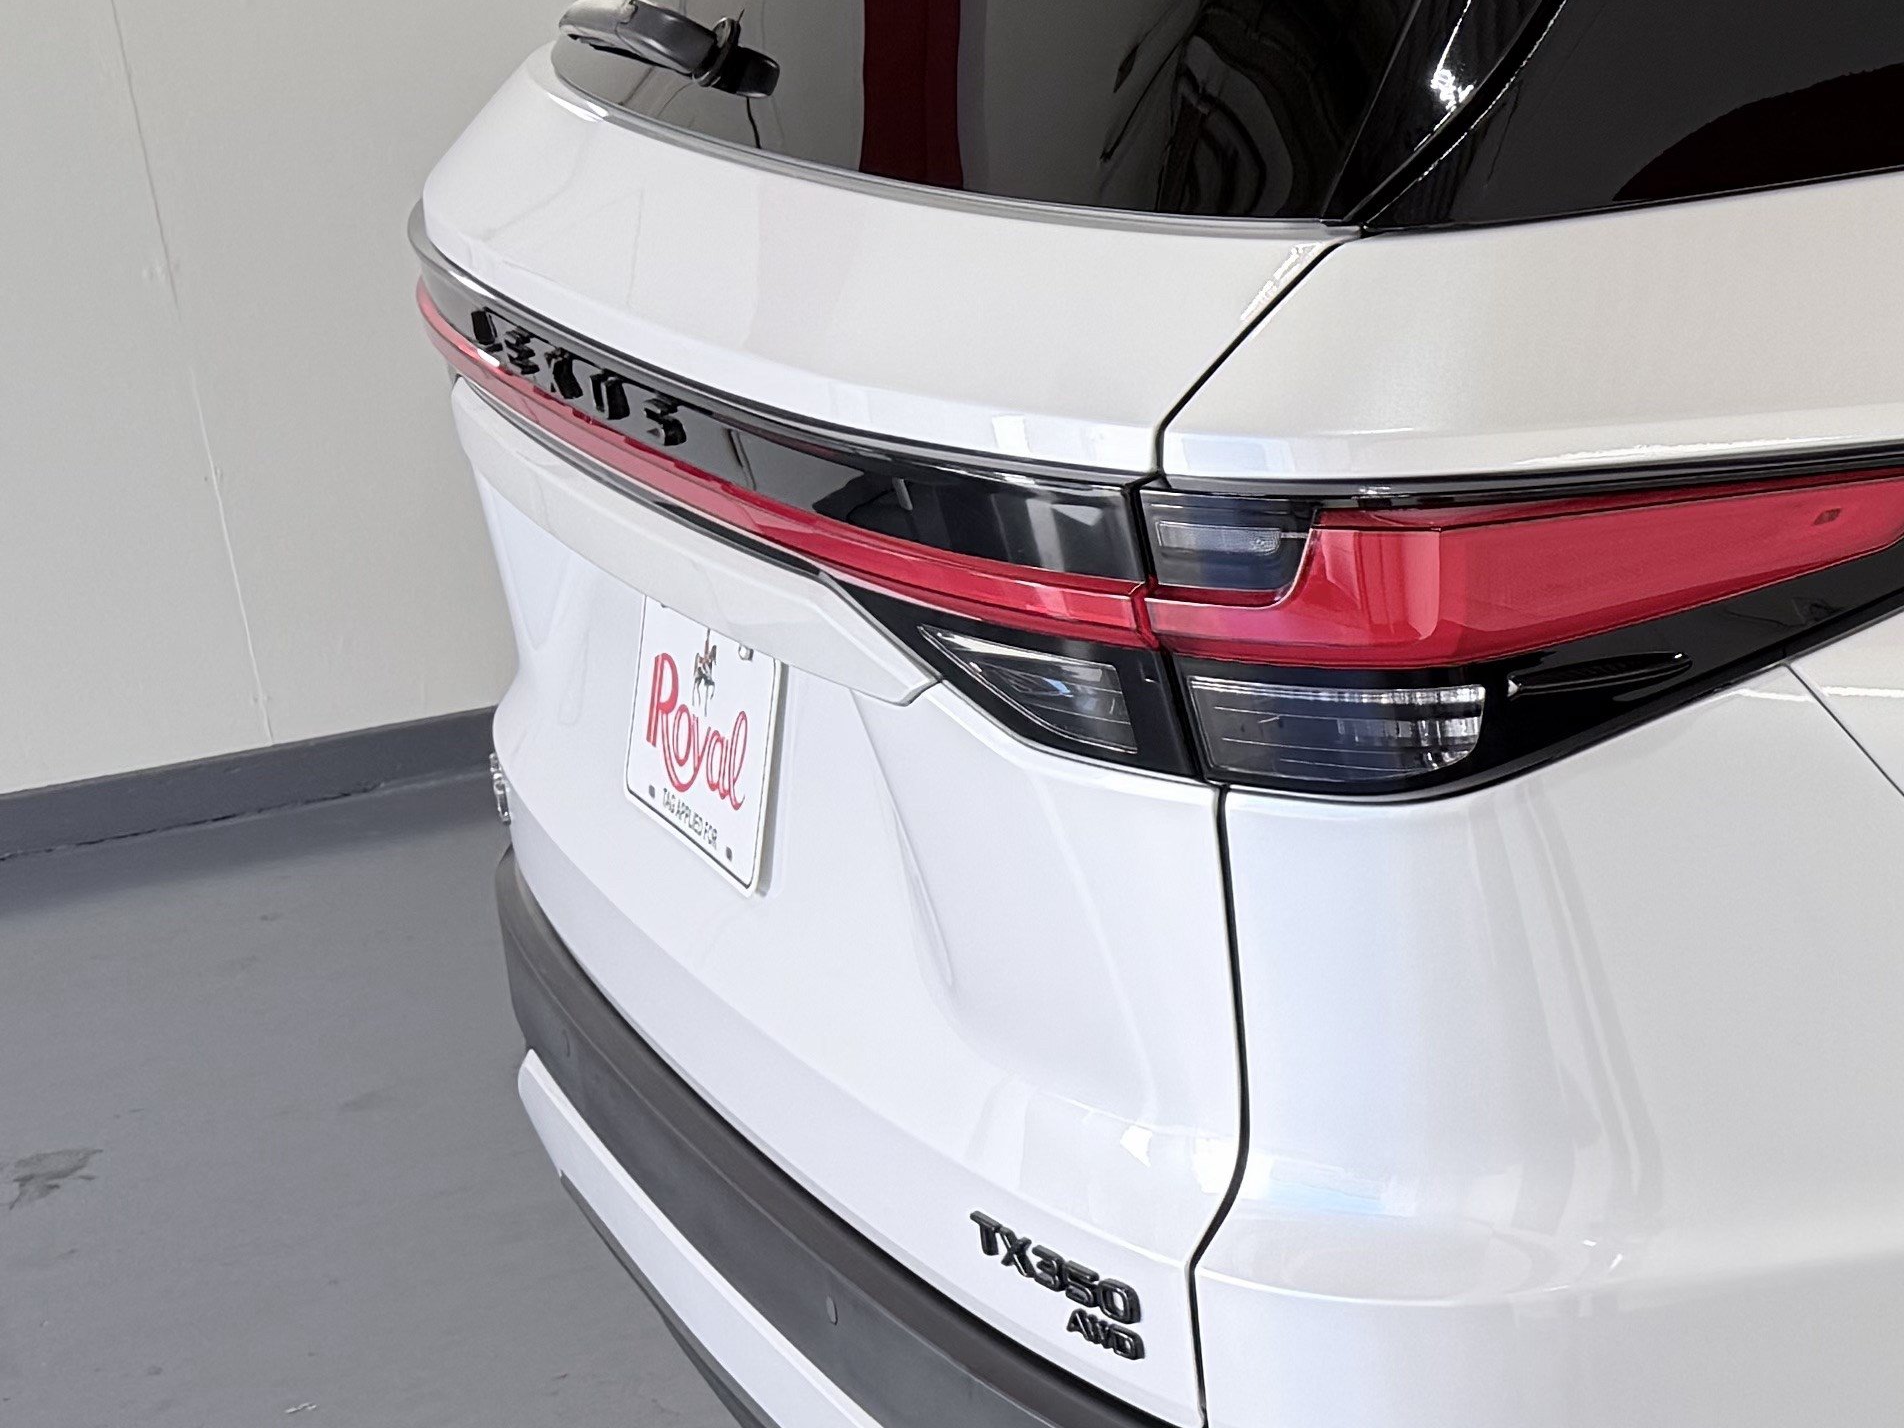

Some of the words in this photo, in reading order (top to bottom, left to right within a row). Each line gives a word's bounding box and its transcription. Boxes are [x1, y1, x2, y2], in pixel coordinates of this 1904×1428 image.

[470, 307, 688, 447] LEXUS
[645, 652, 749, 811] Royal
[703, 821, 718, 851] FOR
[969, 1210, 1142, 1325] TX350
[1066, 1308, 1146, 1361] AWD
